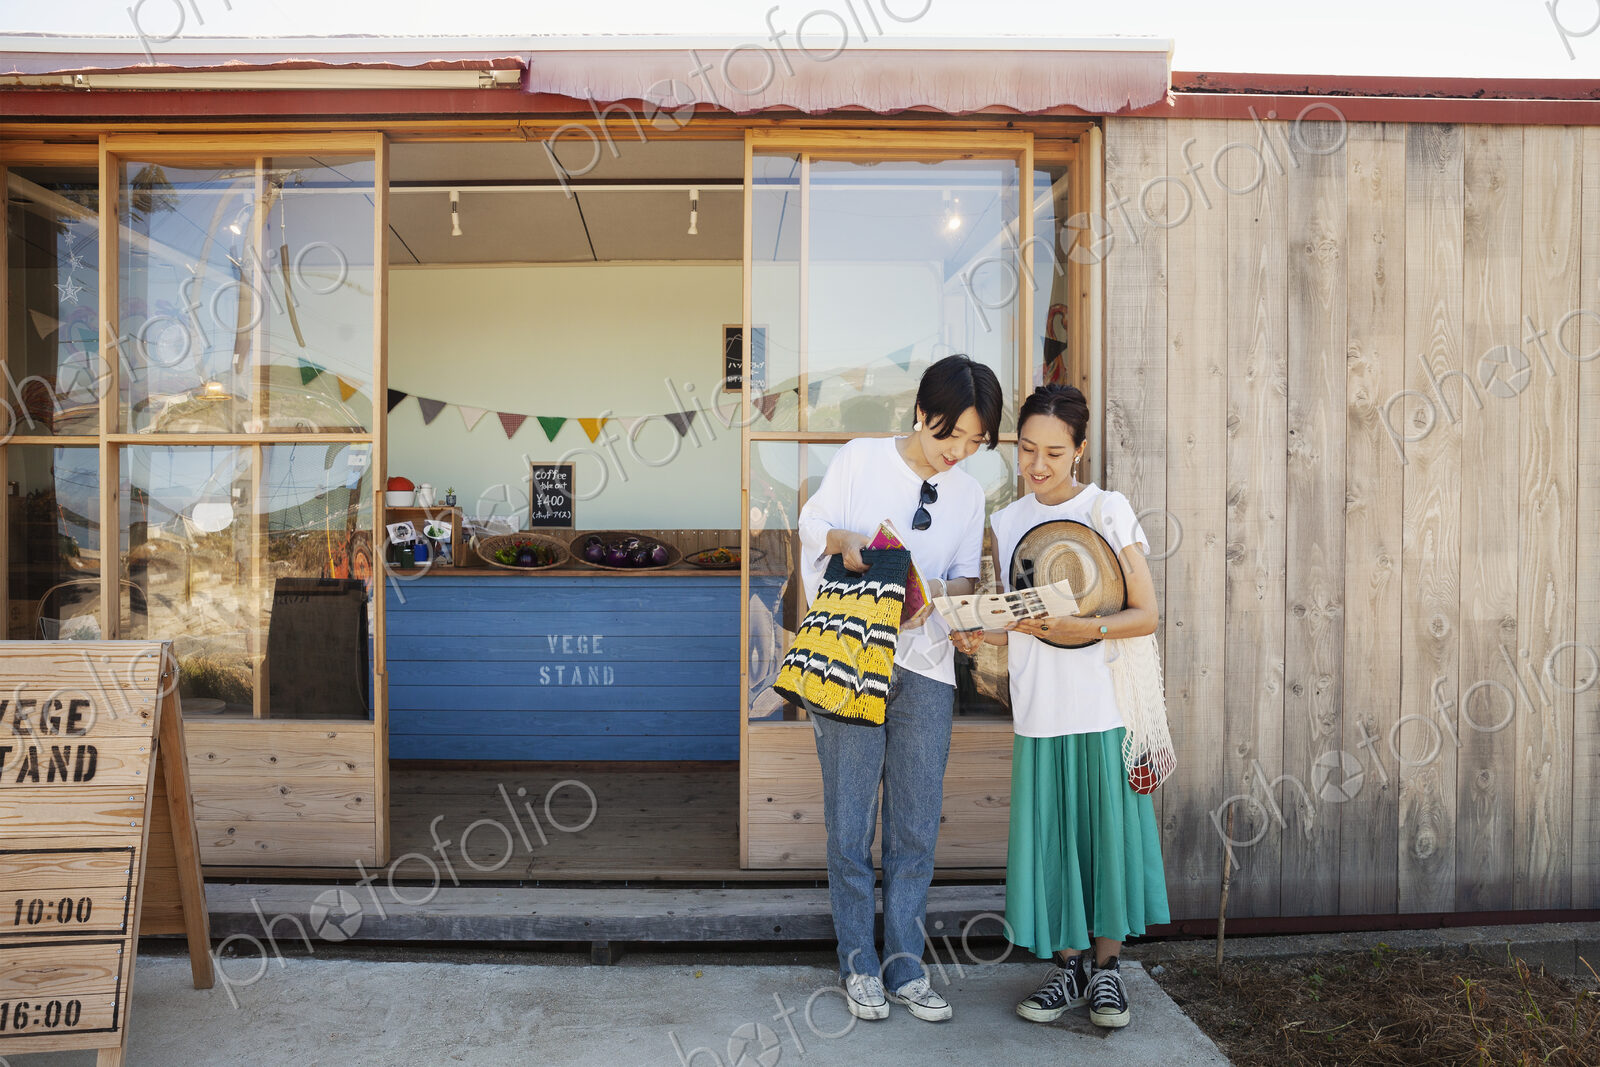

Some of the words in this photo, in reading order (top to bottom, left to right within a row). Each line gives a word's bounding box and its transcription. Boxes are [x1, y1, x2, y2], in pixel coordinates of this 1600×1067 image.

[536, 494, 564, 508] ¥400
[547, 634, 603, 654] VEGE
[539, 665, 614, 685] STAND
[14, 897, 92, 926] 10:00
[0, 999, 82, 1031] 16:00
